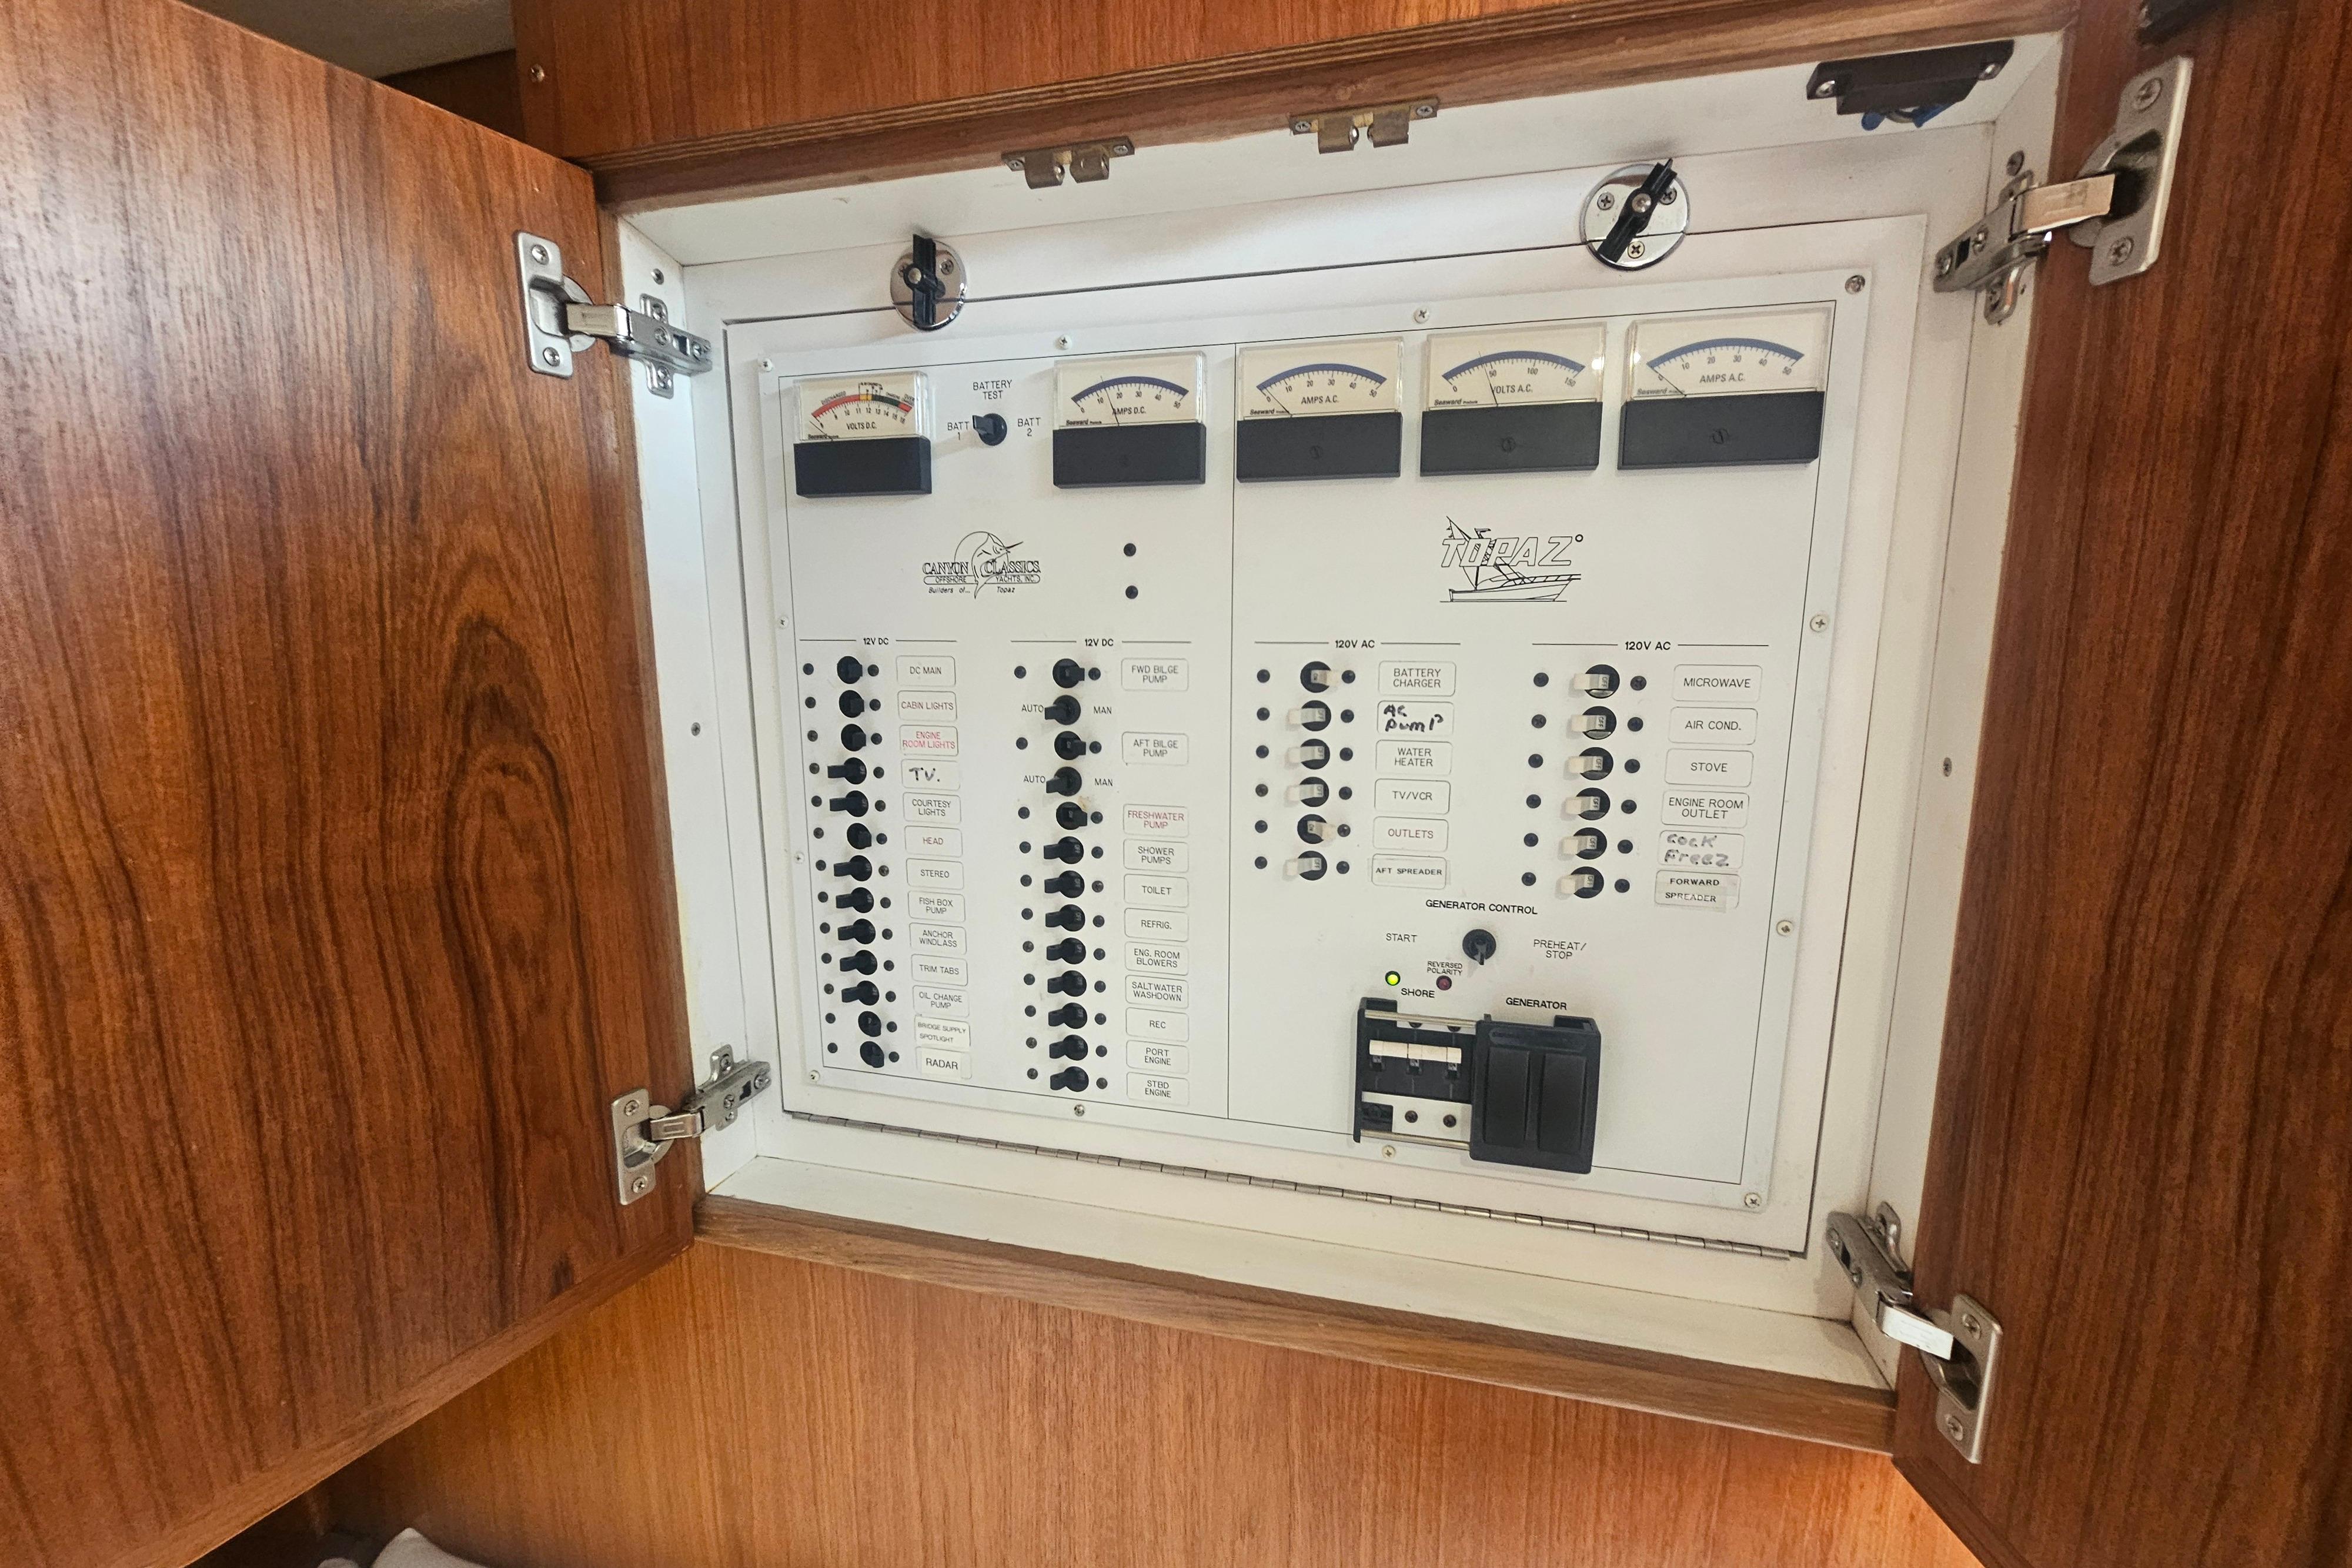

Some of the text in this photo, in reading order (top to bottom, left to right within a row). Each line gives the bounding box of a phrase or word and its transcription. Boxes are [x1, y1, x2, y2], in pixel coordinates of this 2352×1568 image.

[1759, 359, 1767, 367] 40
[1783, 366, 1792, 376] 50
[1564, 377, 1576, 387] 150
[1699, 373, 1745, 383] AMPS A.C.
[973, 380, 1012, 390] BATTERY
[1492, 383, 1534, 394] VOLTS A.C.
[983, 390, 1003, 400] TEST
[1369, 389, 1377, 398] 50
[1301, 395, 1339, 404] AMPS A.C.
[1134, 406, 1146, 414] D.C.
[1173, 401, 1181, 409] 50
[947, 421, 970, 431] BATT
[1017, 417, 1041, 427] BATT
[1027, 428, 1032, 437] 2
[1441, 536, 1573, 567] TOPAZ
[922, 560, 1041, 575] CANYON CLASSICS
[1085, 638, 1114, 647] 12V DC
[1335, 640, 1375, 648] 120V AC
[1625, 641, 1671, 651] 120V AC
[1131, 665, 1179, 674] FWD BILGE
[1394, 668, 1441, 677] BATTERY
[1142, 675, 1167, 683] PUMP
[1393, 679, 1441, 688] CHARGER
[1683, 678, 1751, 688] MICROWAVE
[1021, 704, 1044, 713] AUTO
[1093, 707, 1112, 715] MAN
[1685, 720, 1742, 731] AIR COND.
[916, 731, 941, 740] ENGINE
[927, 741, 956, 749] LIGHTS
[1134, 739, 1178, 748] AFT BILGE
[1143, 749, 1168, 757] PUMP
[1398, 748, 1431, 757] WATER
[1395, 758, 1433, 767] HEATER
[1690, 763, 1728, 773] STOVE
[1023, 775, 1045, 783] AUTO
[1094, 778, 1113, 787] MAN
[1392, 791, 1432, 800] TV/VCR
[912, 799, 951, 808] COURTESY
[1669, 797, 1743, 809] ENGINE ROOM
[918, 808, 946, 817] LIGHTS
[1127, 810, 1184, 821] FRESHWATER
[1682, 808, 1728, 819] OUTLET
[1144, 821, 1168, 829] PUMP
[1388, 828, 1434, 838] OUTLETS
[1138, 846, 1174, 856] SHOWER
[1141, 856, 1171, 865] PUMPS
[920, 870, 950, 878] STEREO
[1670, 878, 1720, 886] FORWARD
[1142, 885, 1172, 895] TOILET
[1665, 892, 1716, 902] SPREADER
[926, 906, 947, 914] PUMP
[1425, 899, 1538, 915] GENERATOR CONTROL
[1141, 920, 1172, 930] REFRIG.
[922, 930, 953, 938] ANCHOR
[1385, 932, 1418, 943] START
[919, 937, 957, 947] WINDLASS
[1534, 939, 1587, 951] PREHEAT/
[1134, 948, 1180, 959] ENG. ROOM
[1545, 950, 1573, 960] STOP
[1137, 958, 1178, 968] BLOWERS
[1427, 960, 1463, 969] REVERSED
[919, 964, 959, 975] TRIM TABS
[1426, 967, 1463, 977] POLARITY
[933, 993, 963, 1002] CHANGE
[1133, 991, 1181, 1002] WASHDOWN
[1401, 988, 1435, 998] SHORE
[931, 1001, 951, 1009] PUMP
[1505, 997, 1568, 1011] GENERATOR
[917, 1022, 966, 1034] BRIDGE SUPPLY
[1150, 1020, 1166, 1028] REC
[920, 1033, 954, 1044] SPOTLIGHT
[1146, 1048, 1170, 1057] PORT
[926, 1058, 958, 1070] RADAR
[1144, 1055, 1171, 1066] ENGINE
[1147, 1079, 1170, 1089] STBD
[1145, 1088, 1172, 1098] ENGINE
